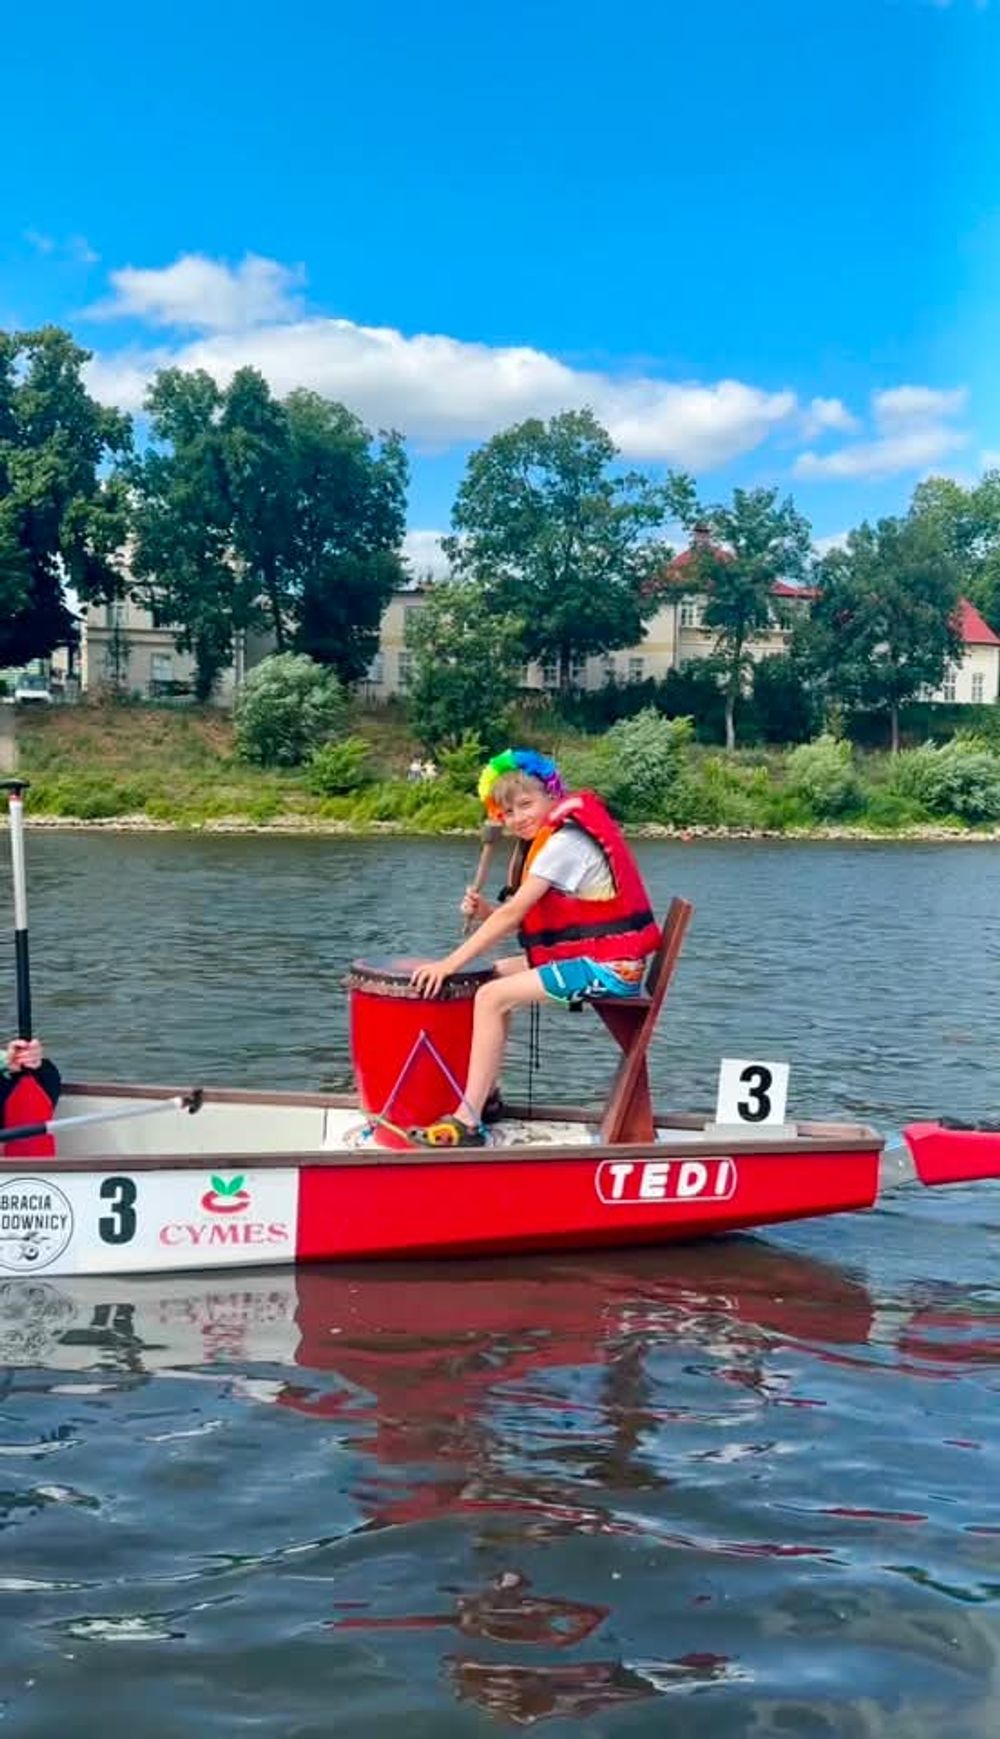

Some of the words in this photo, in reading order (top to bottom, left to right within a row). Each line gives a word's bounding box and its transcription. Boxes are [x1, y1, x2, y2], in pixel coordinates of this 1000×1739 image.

[737, 1065, 773, 1123] 3
[609, 1161, 730, 1199] TEDI
[0, 1195, 51, 1211] BRACIA
[99, 1176, 137, 1245] 3
[0, 1214, 67, 1230] DOWNICY
[159, 1222, 289, 1245] CYMES
